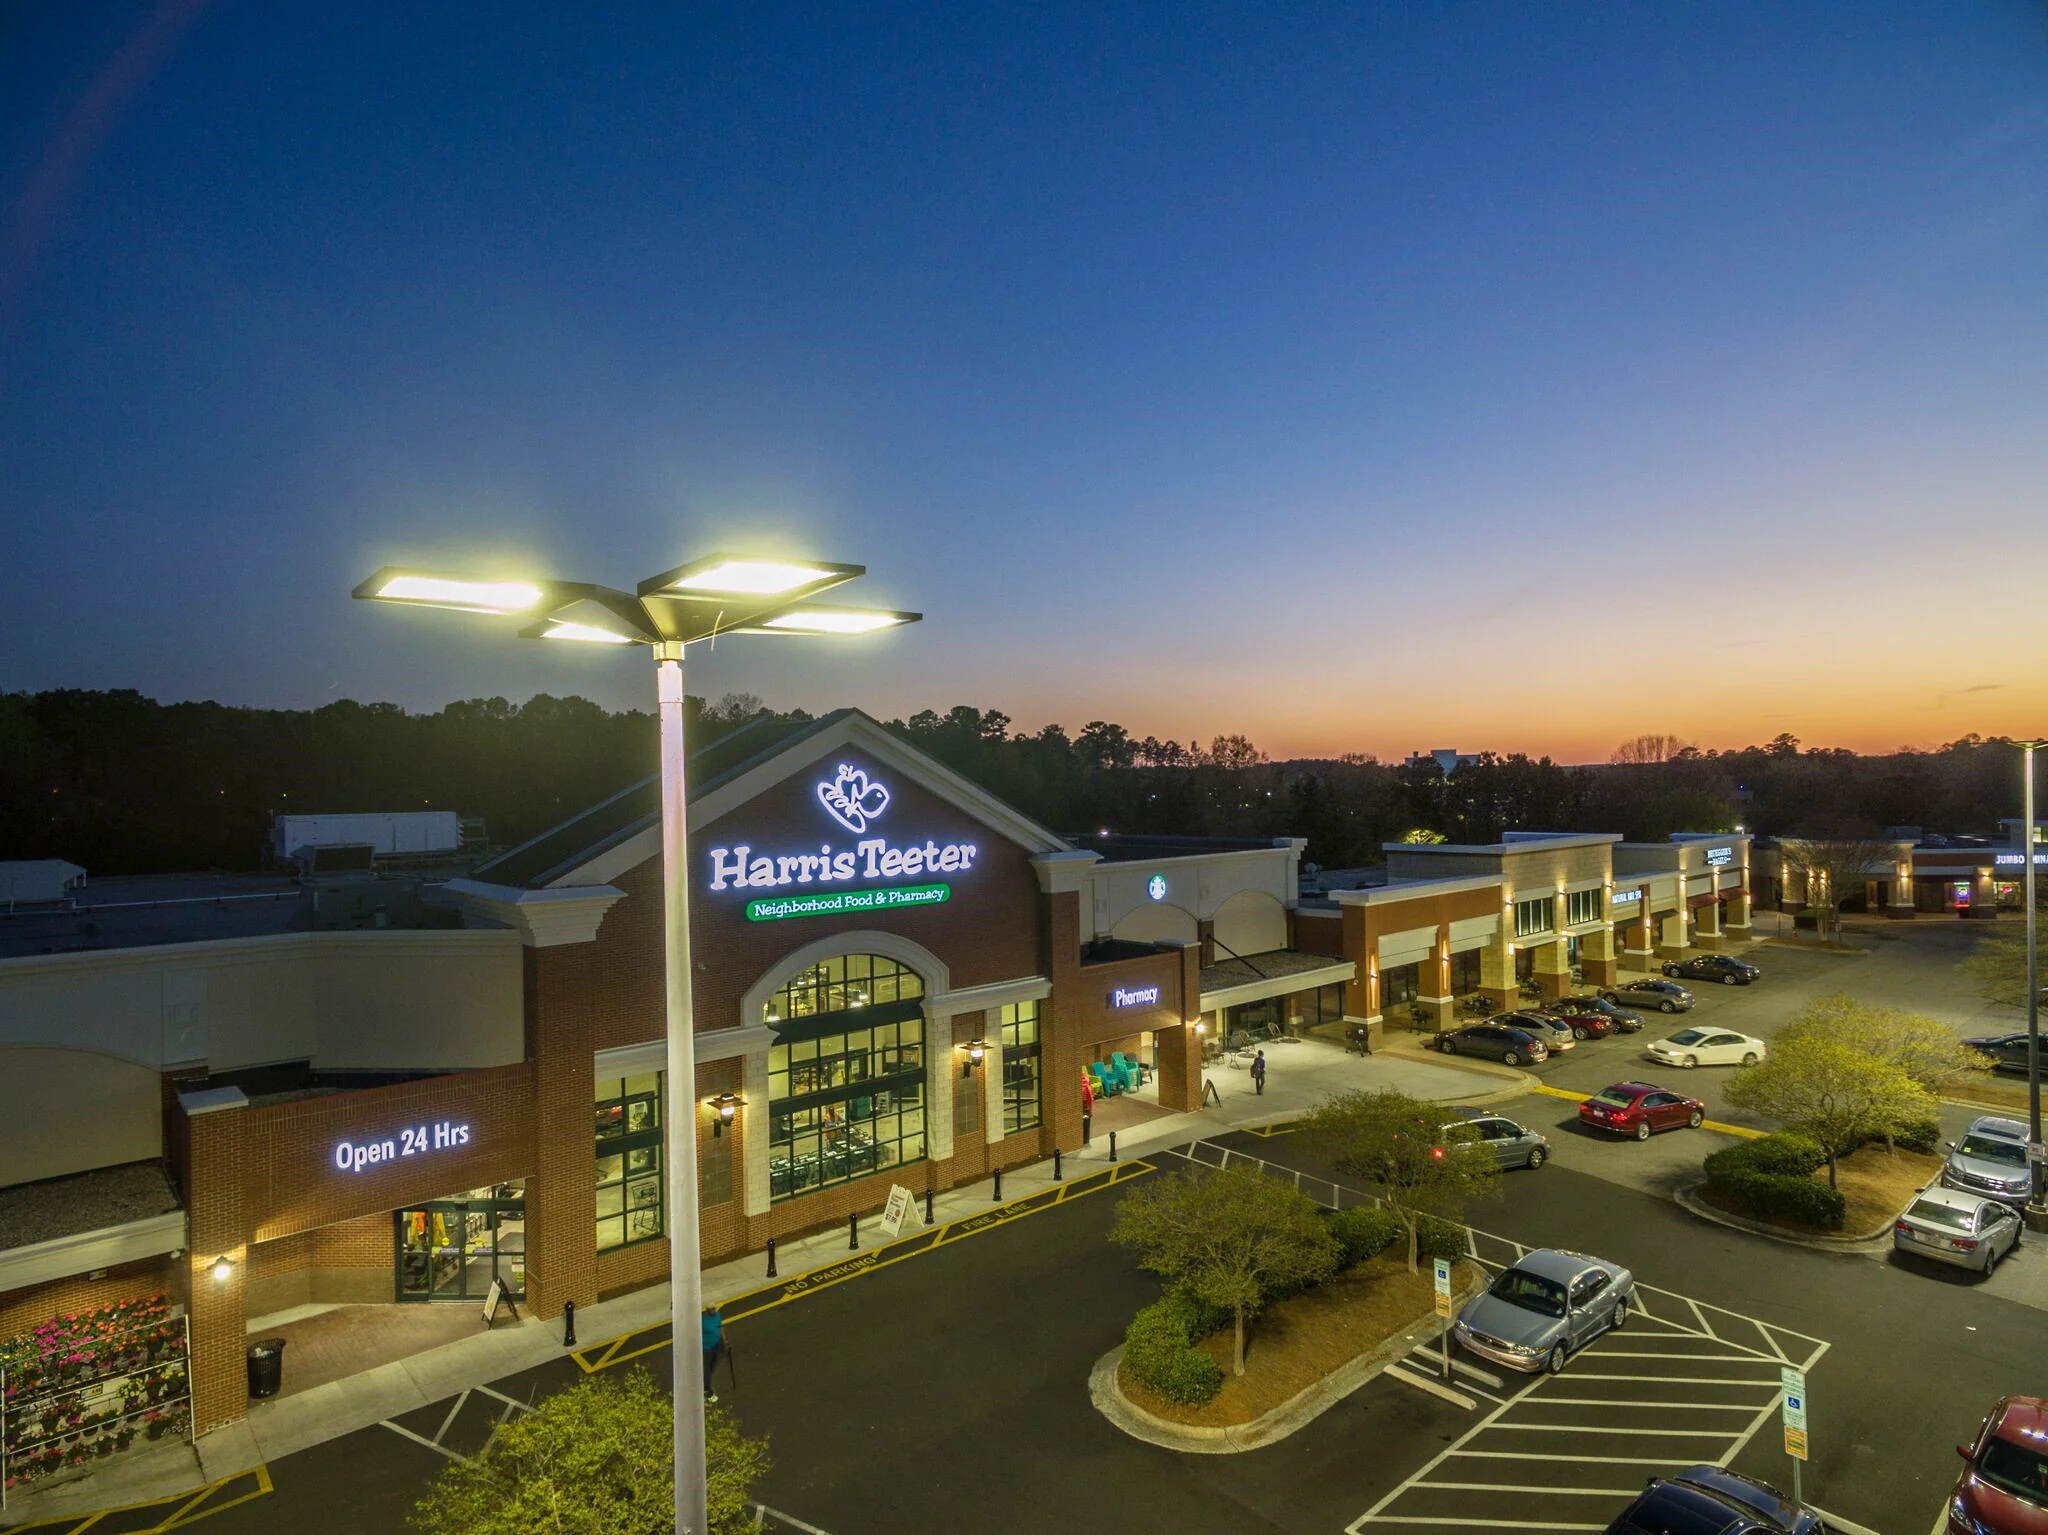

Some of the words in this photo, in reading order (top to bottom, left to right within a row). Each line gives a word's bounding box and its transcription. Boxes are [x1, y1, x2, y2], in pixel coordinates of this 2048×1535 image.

[710, 845, 855, 890] Harris
[858, 838, 977, 878] Teeter
[1995, 855, 2025, 865] JUMBO
[2032, 855, 2048, 865] HIN
[755, 894, 842, 917] Neighborhood
[845, 892, 875, 907] Food
[875, 892, 887, 904] &
[889, 889, 944, 903] Pharmacy
[1115, 987, 1158, 1007] Pharmacy
[336, 1141, 394, 1172] Open
[401, 1126, 428, 1156] 24
[434, 1122, 469, 1149] Hrs
[961, 1215, 995, 1231] FIRE
[995, 1203, 1032, 1218] LANE
[784, 1280, 808, 1293] NO
[812, 1257, 877, 1283] PARKING
